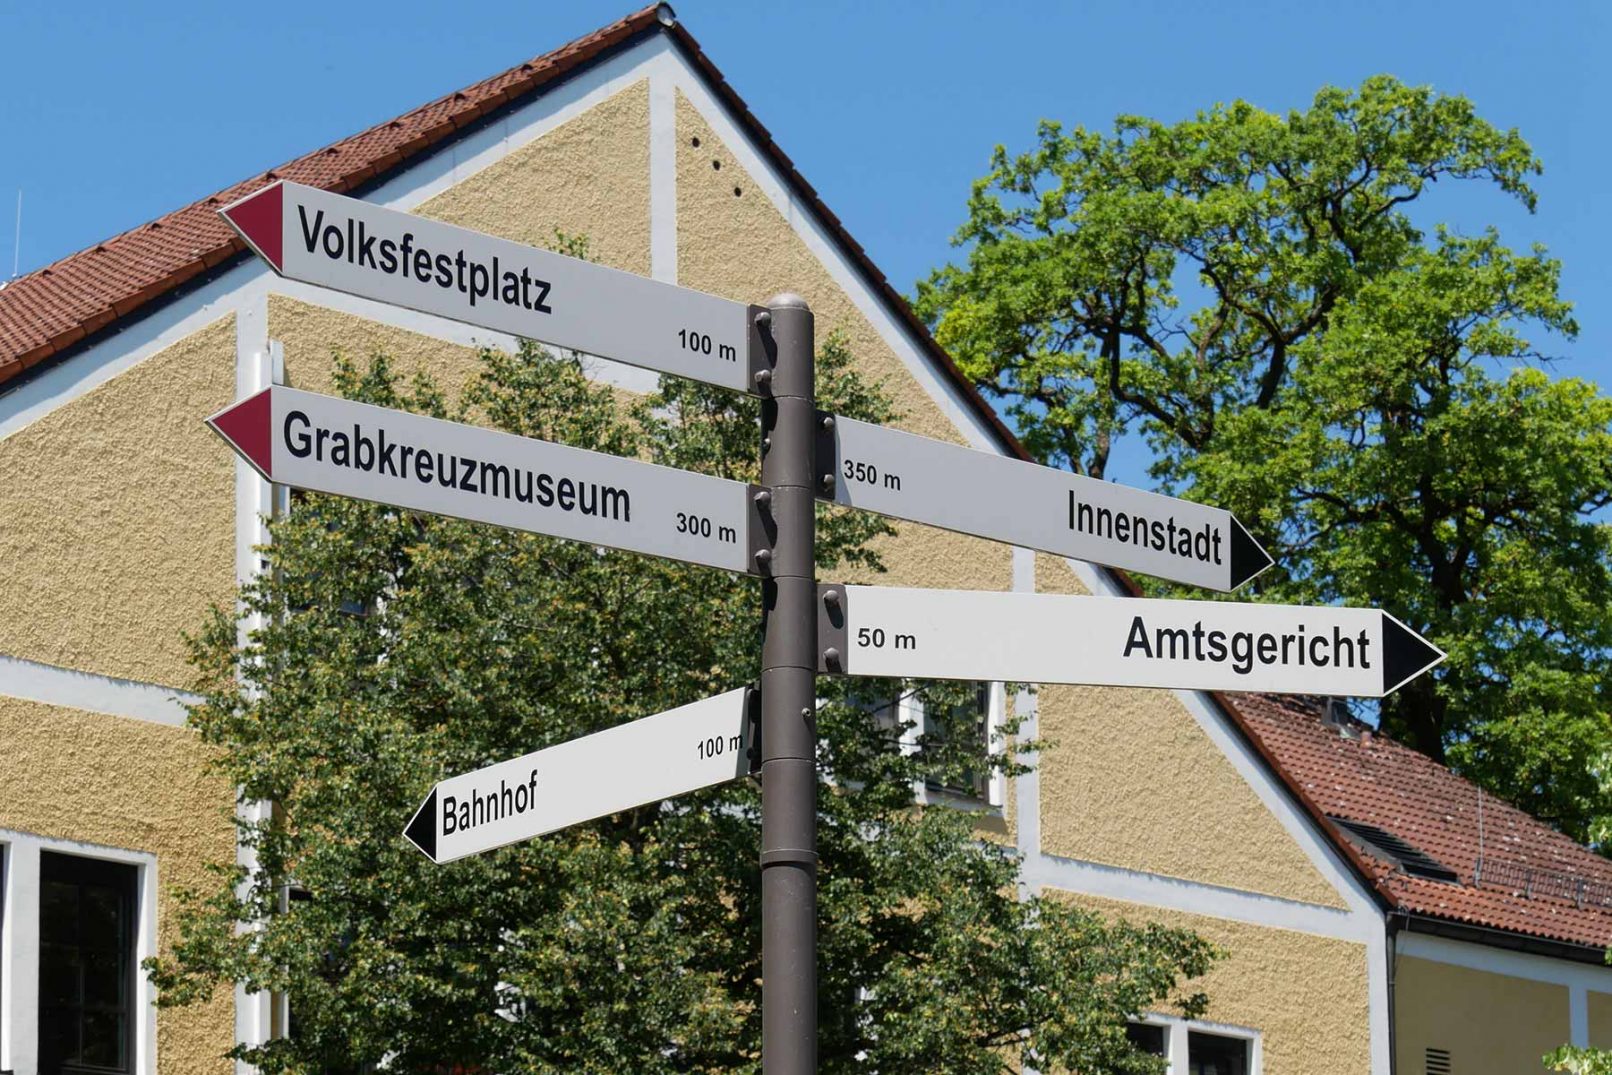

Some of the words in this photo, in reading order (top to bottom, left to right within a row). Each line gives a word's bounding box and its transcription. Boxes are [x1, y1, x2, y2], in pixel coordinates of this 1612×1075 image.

[297, 204, 552, 315] Volksfestplatz
[678, 328, 712, 356] 100
[719, 343, 736, 363] m
[283, 410, 631, 523] Grabkreuzmuseum
[676, 512, 712, 538] 300
[718, 525, 737, 544] m
[843, 459, 878, 485] 350
[884, 473, 901, 491] m
[1068, 489, 1222, 566] Innenstadt
[857, 627, 885, 648] 50
[895, 634, 916, 650] m
[1123, 615, 1371, 675] Amtsgericht
[442, 769, 538, 836] Bahnhof
[697, 735, 724, 760] 100
[729, 734, 743, 752] m
